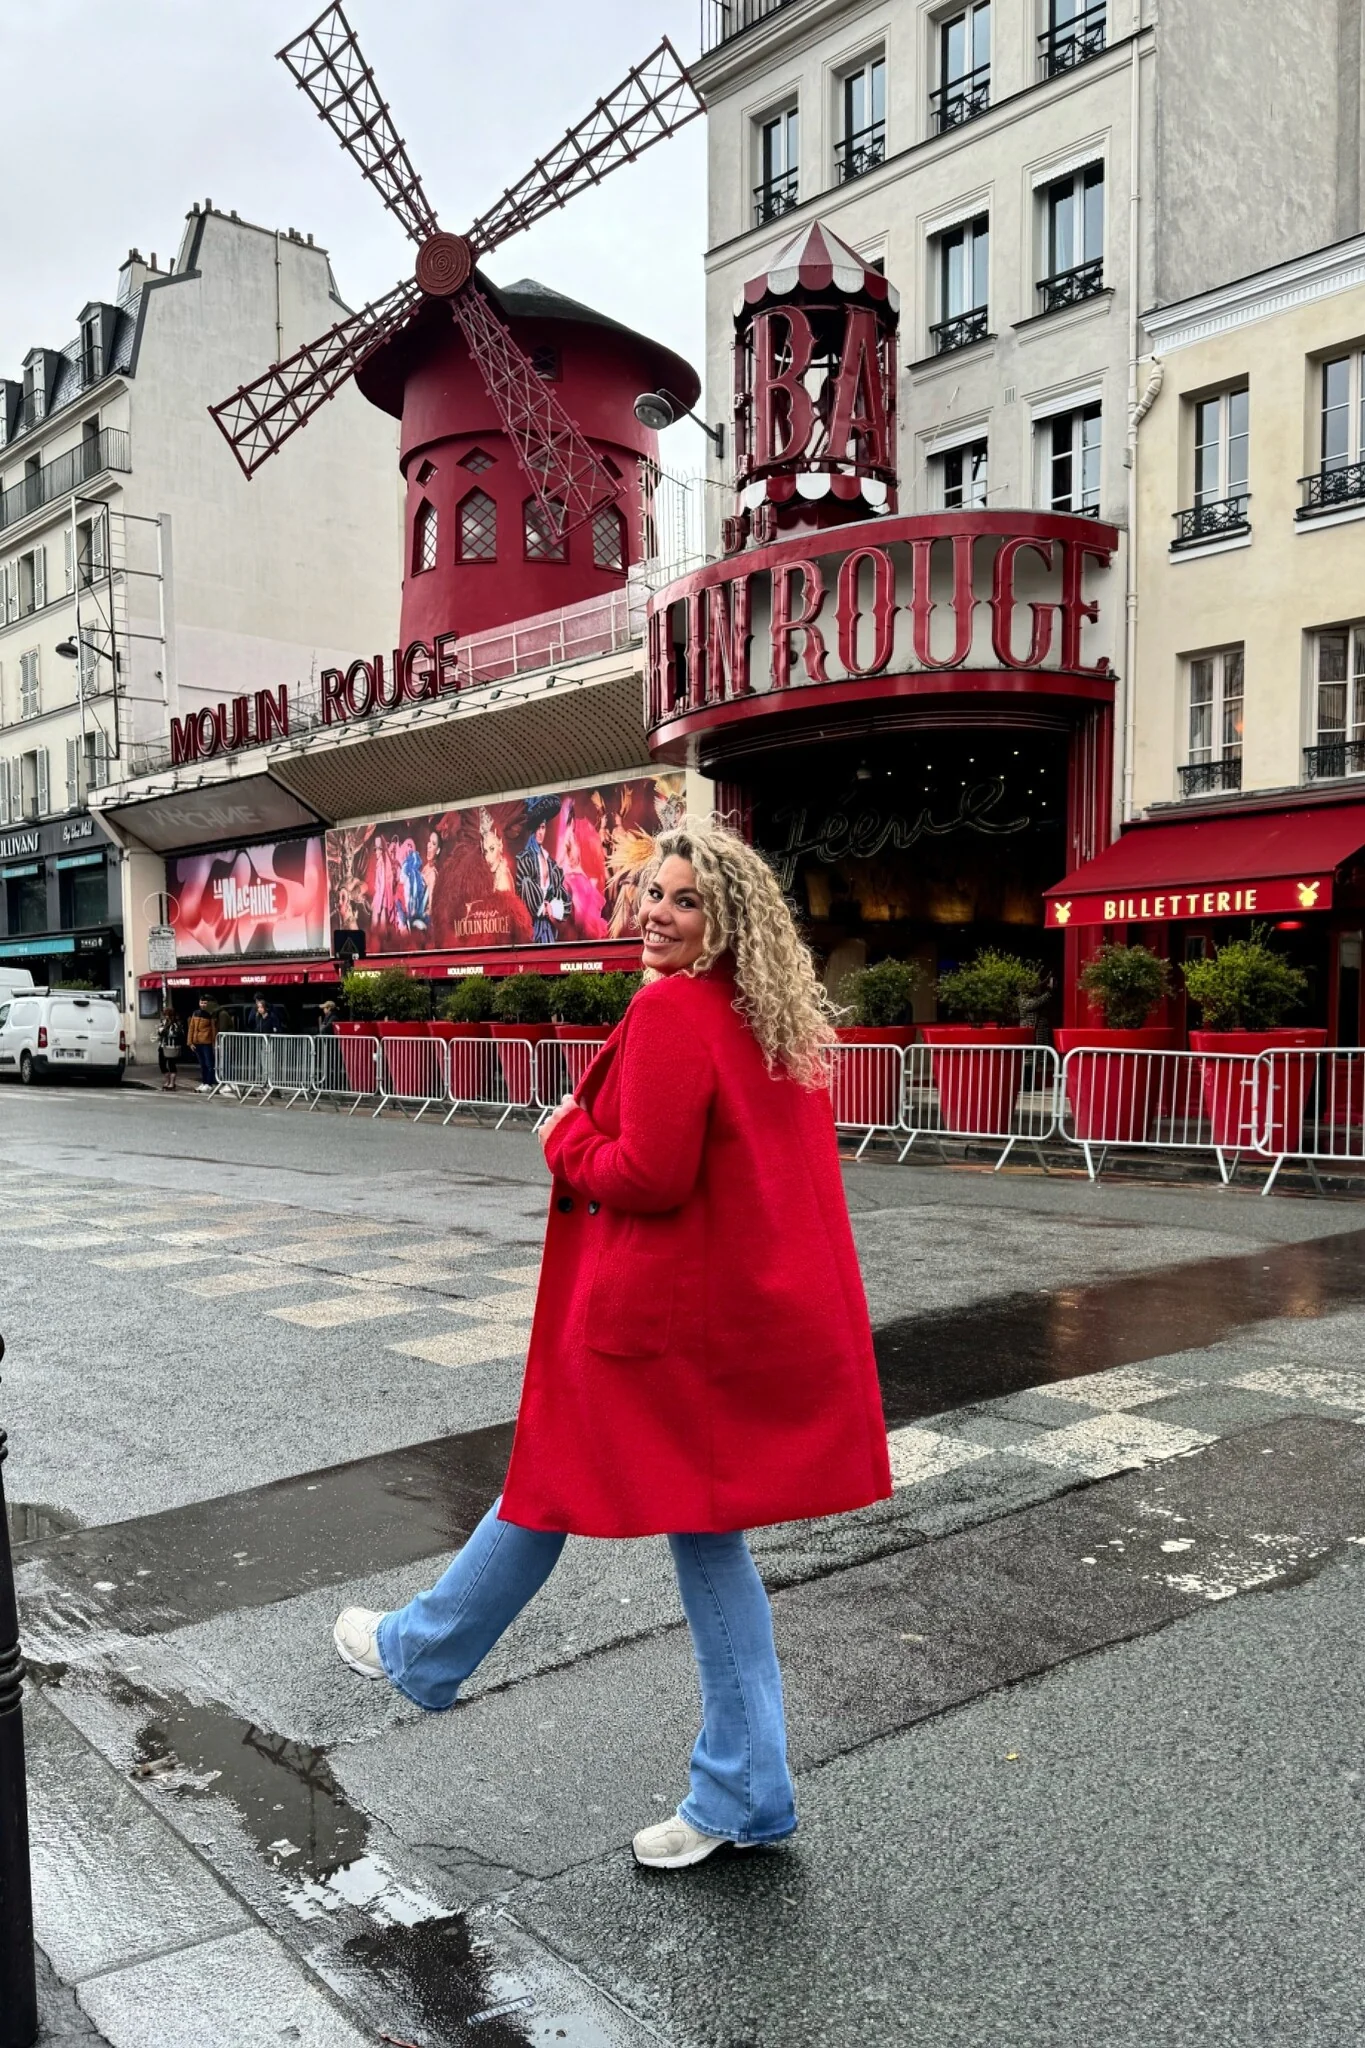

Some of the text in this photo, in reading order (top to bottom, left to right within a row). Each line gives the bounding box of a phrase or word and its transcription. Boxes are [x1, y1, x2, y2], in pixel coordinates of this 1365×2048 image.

[751, 303, 897, 469] BA
[721, 503, 778, 553] DU
[648, 534, 1113, 728] LIN ROUGE
[170, 632, 461, 765] MOULIN ROUGE
[453, 916, 510, 937] MOULIN ROUGE
[1103, 889, 1257, 920] BILLETTERIE
